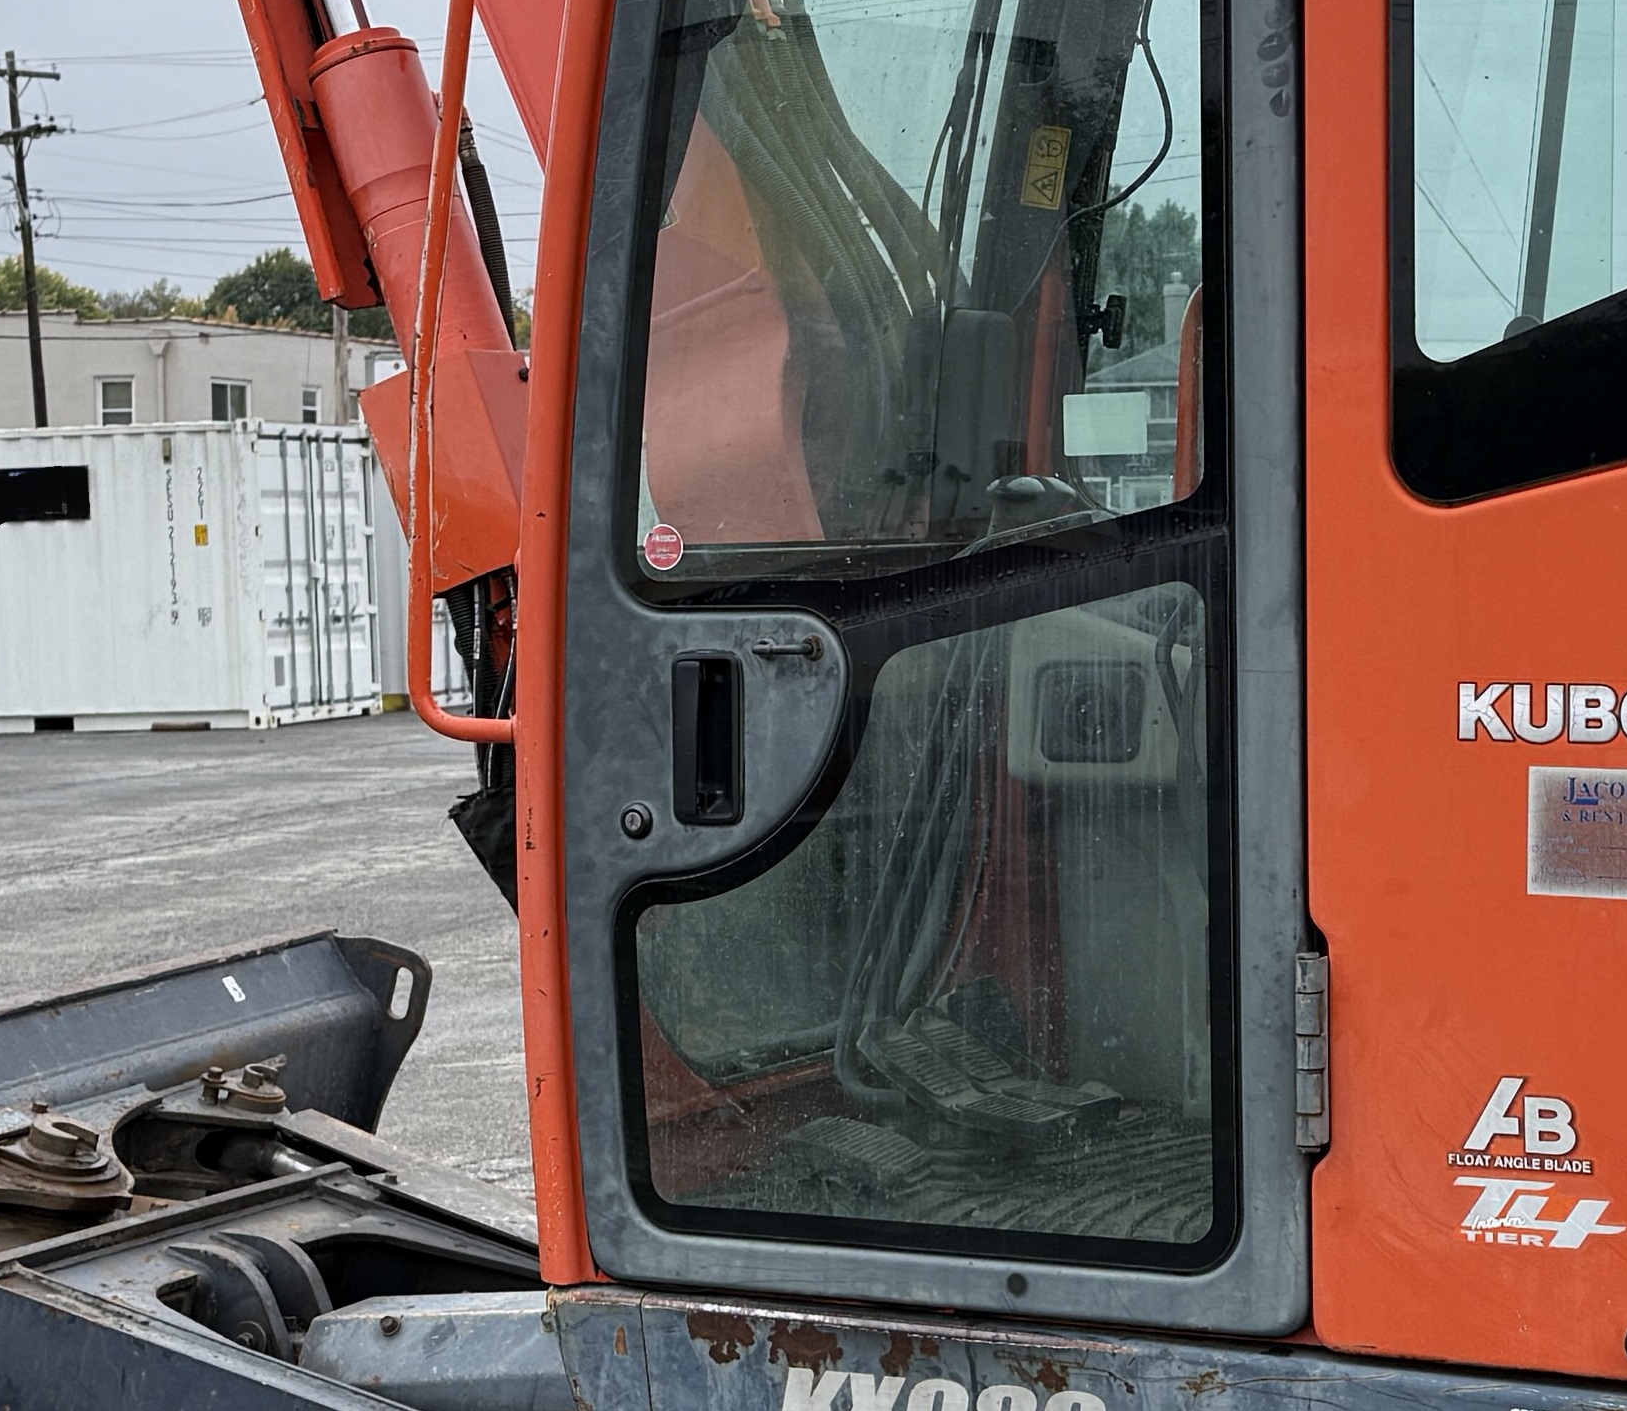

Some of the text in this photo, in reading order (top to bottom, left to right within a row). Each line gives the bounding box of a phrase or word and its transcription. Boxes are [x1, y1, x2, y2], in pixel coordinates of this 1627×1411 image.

[1462, 1076, 1578, 1156] AB
[1448, 1153, 1592, 1174] FLOAT ANGLE BLADE
[1460, 1229, 1544, 1247] TIER
